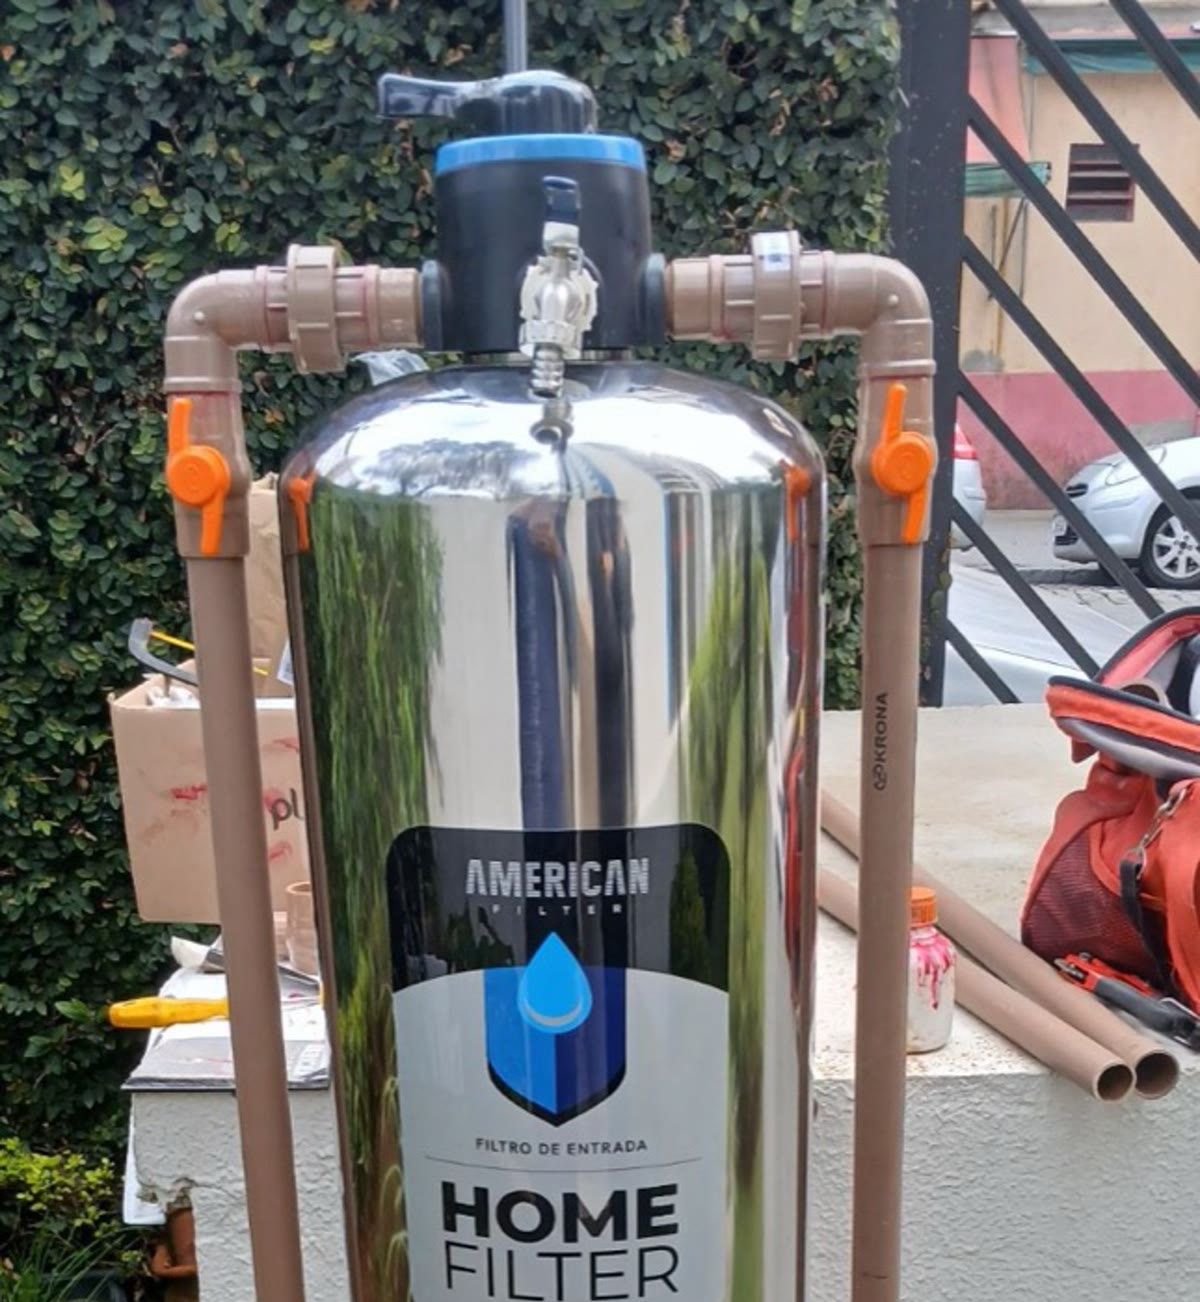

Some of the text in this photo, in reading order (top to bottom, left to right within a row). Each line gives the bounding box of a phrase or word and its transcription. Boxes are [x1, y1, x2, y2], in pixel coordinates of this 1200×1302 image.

[873, 691, 888, 763] KRONA
[465, 857, 649, 898] AMERICAN
[492, 903, 622, 916] FILTER
[475, 1137, 648, 1156] FILTRO DE ENTRADA
[441, 1180, 679, 1243] HOME
[445, 1240, 679, 1302] FILTER
